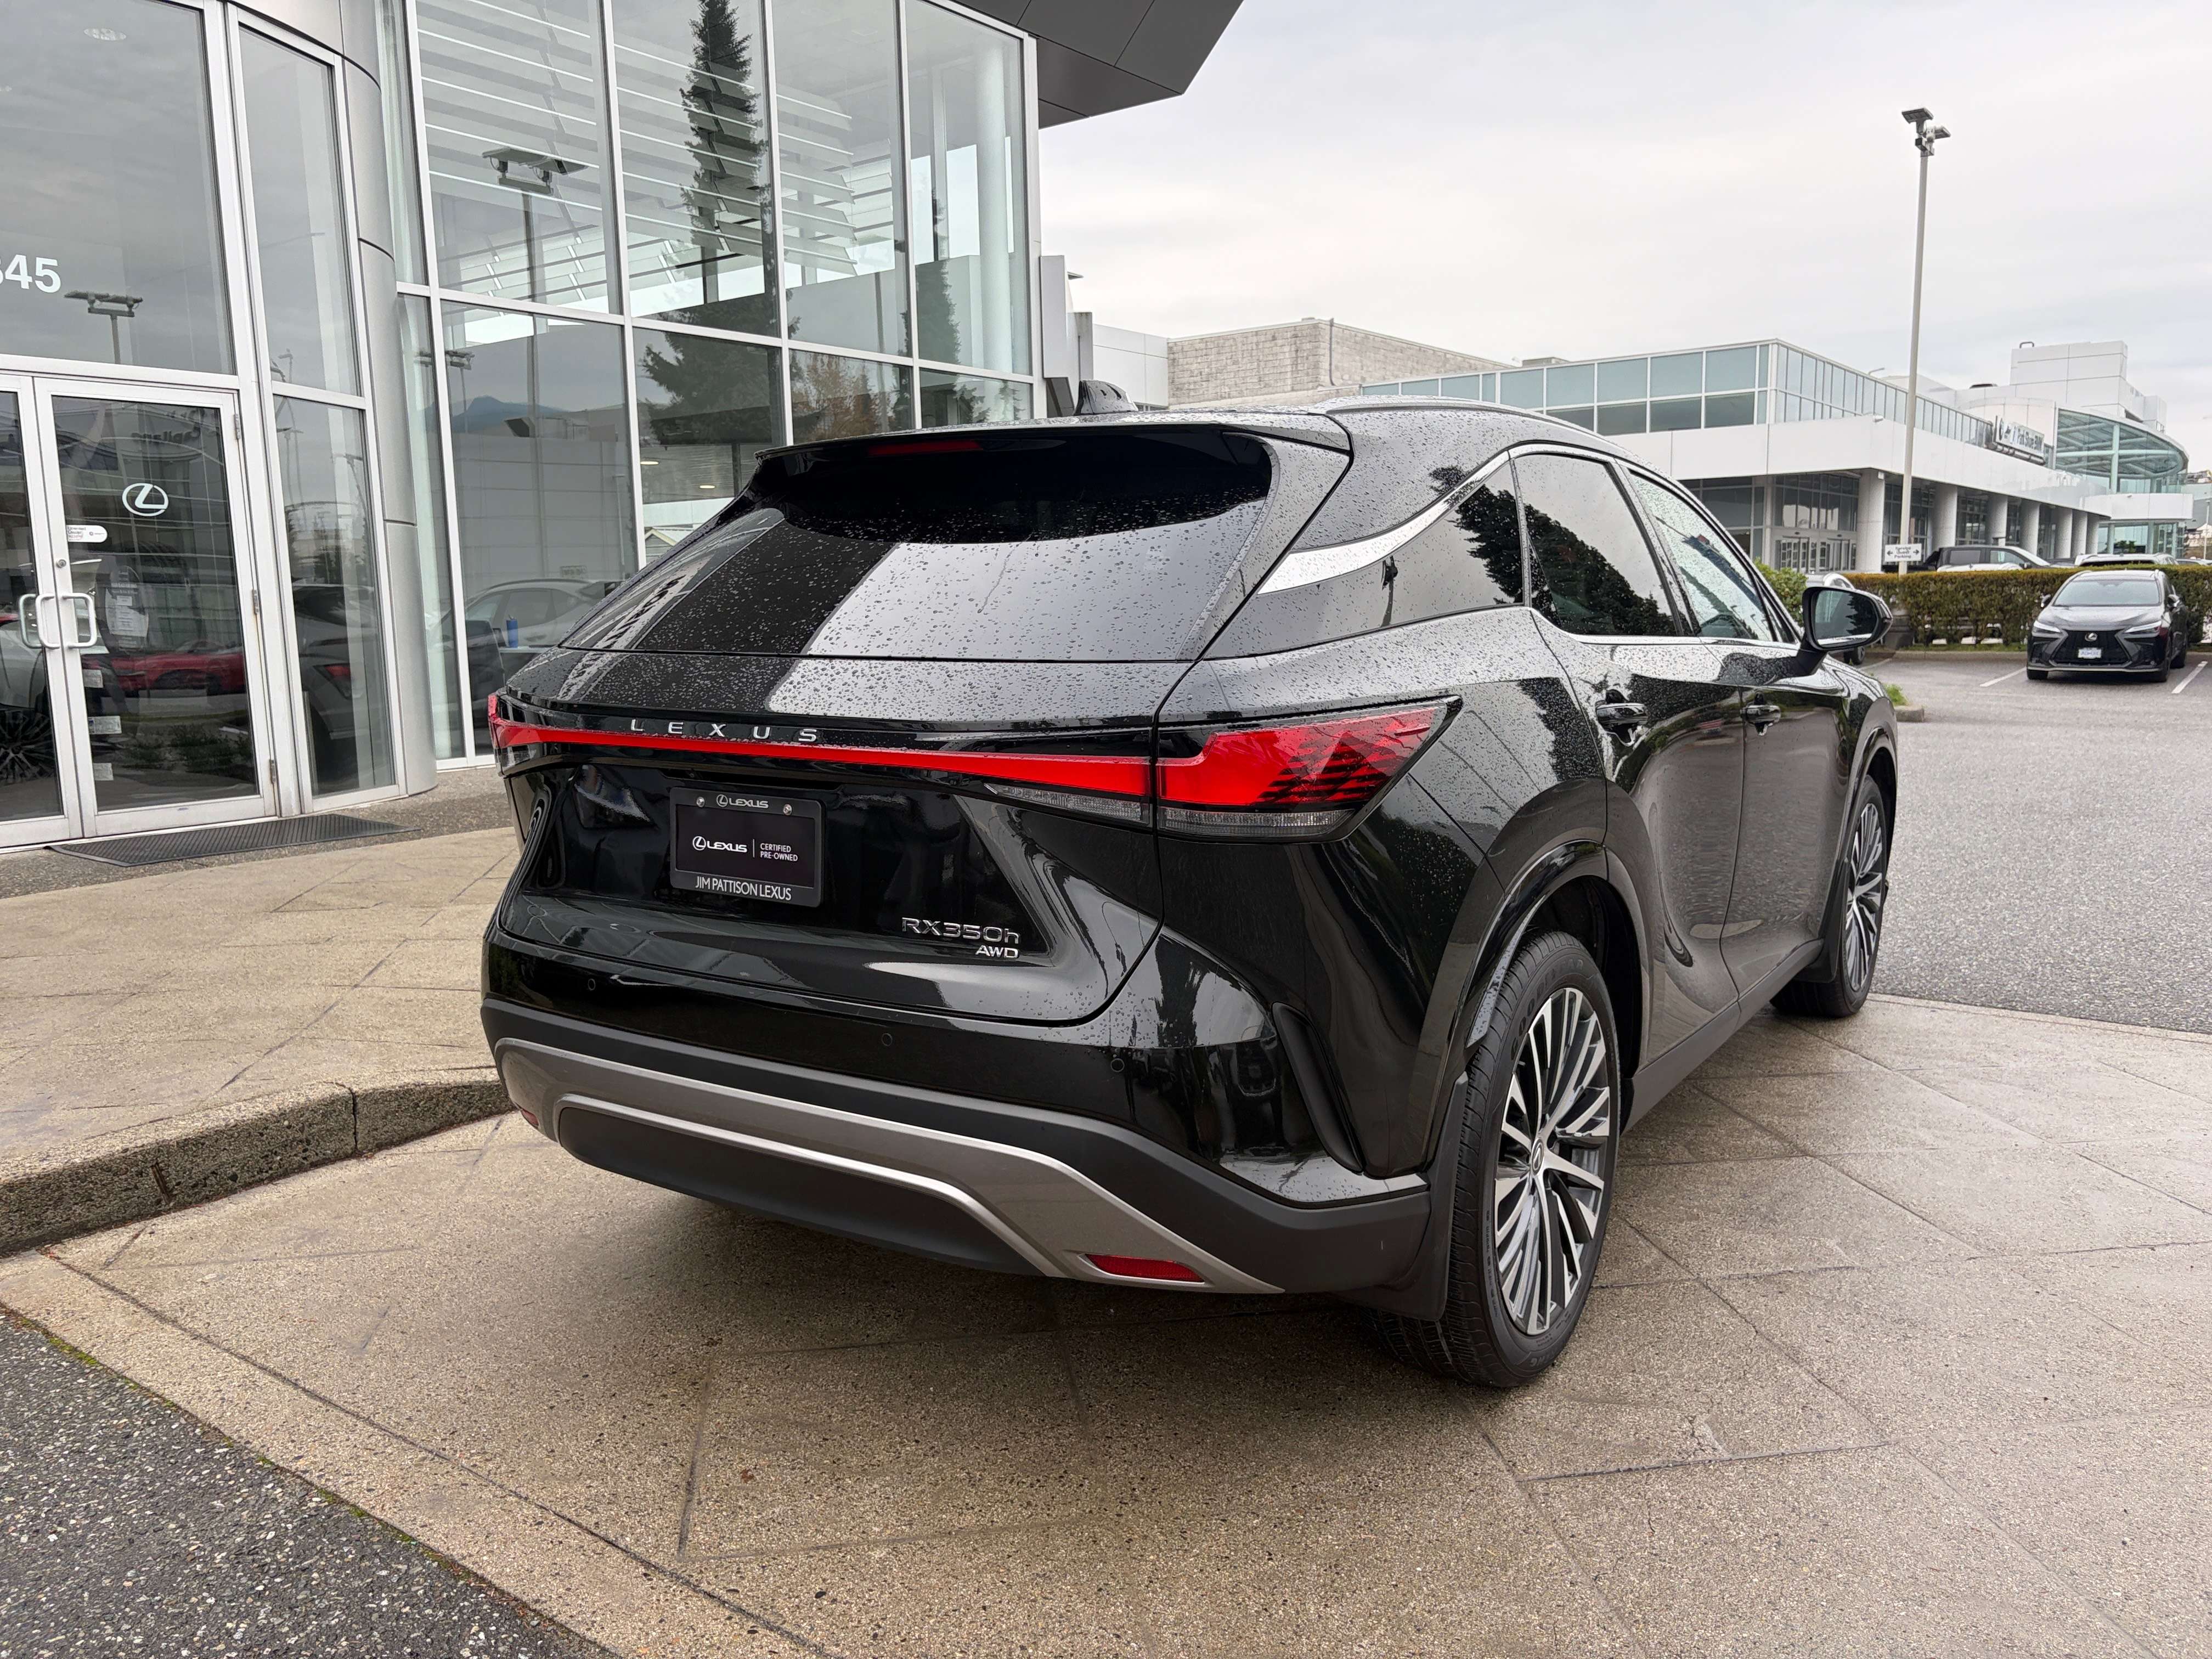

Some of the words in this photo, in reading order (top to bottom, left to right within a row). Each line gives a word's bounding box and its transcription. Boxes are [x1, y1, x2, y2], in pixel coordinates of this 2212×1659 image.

[0, 254, 61, 294] 45
[630, 719, 817, 742] LEXUS
[729, 798, 769, 809] LEXUS
[707, 842, 747, 853] LEXUS
[760, 843, 792, 853] CERTIFIED
[760, 851, 798, 862] PRE-OWNED
[696, 876, 710, 890] JIM
[712, 878, 758, 896] PATTISON
[759, 885, 792, 901] LEXUS
[901, 917, 1020, 944] RX350h
[975, 945, 1019, 959] AWD
